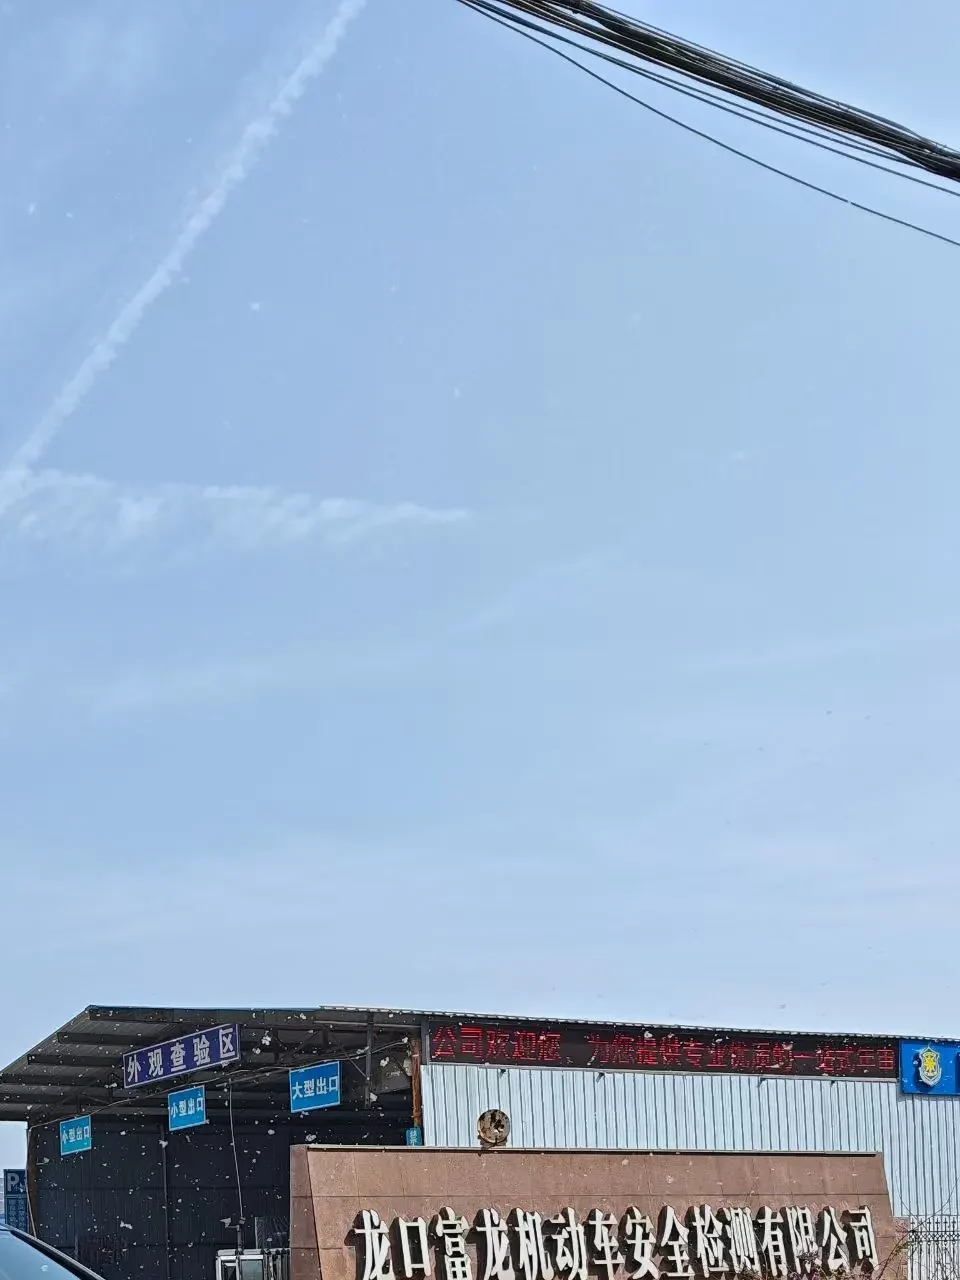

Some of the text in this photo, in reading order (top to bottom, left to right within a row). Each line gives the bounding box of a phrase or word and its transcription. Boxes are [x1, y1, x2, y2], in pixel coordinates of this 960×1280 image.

[127, 1028, 236, 1083] 外观查验区
[432, 1026, 562, 1062] 公司欢迎您
[291, 1076, 339, 1100] 大型出口
[170, 1097, 204, 1118] 小型出口
[62, 1125, 90, 1144] 小型出口
